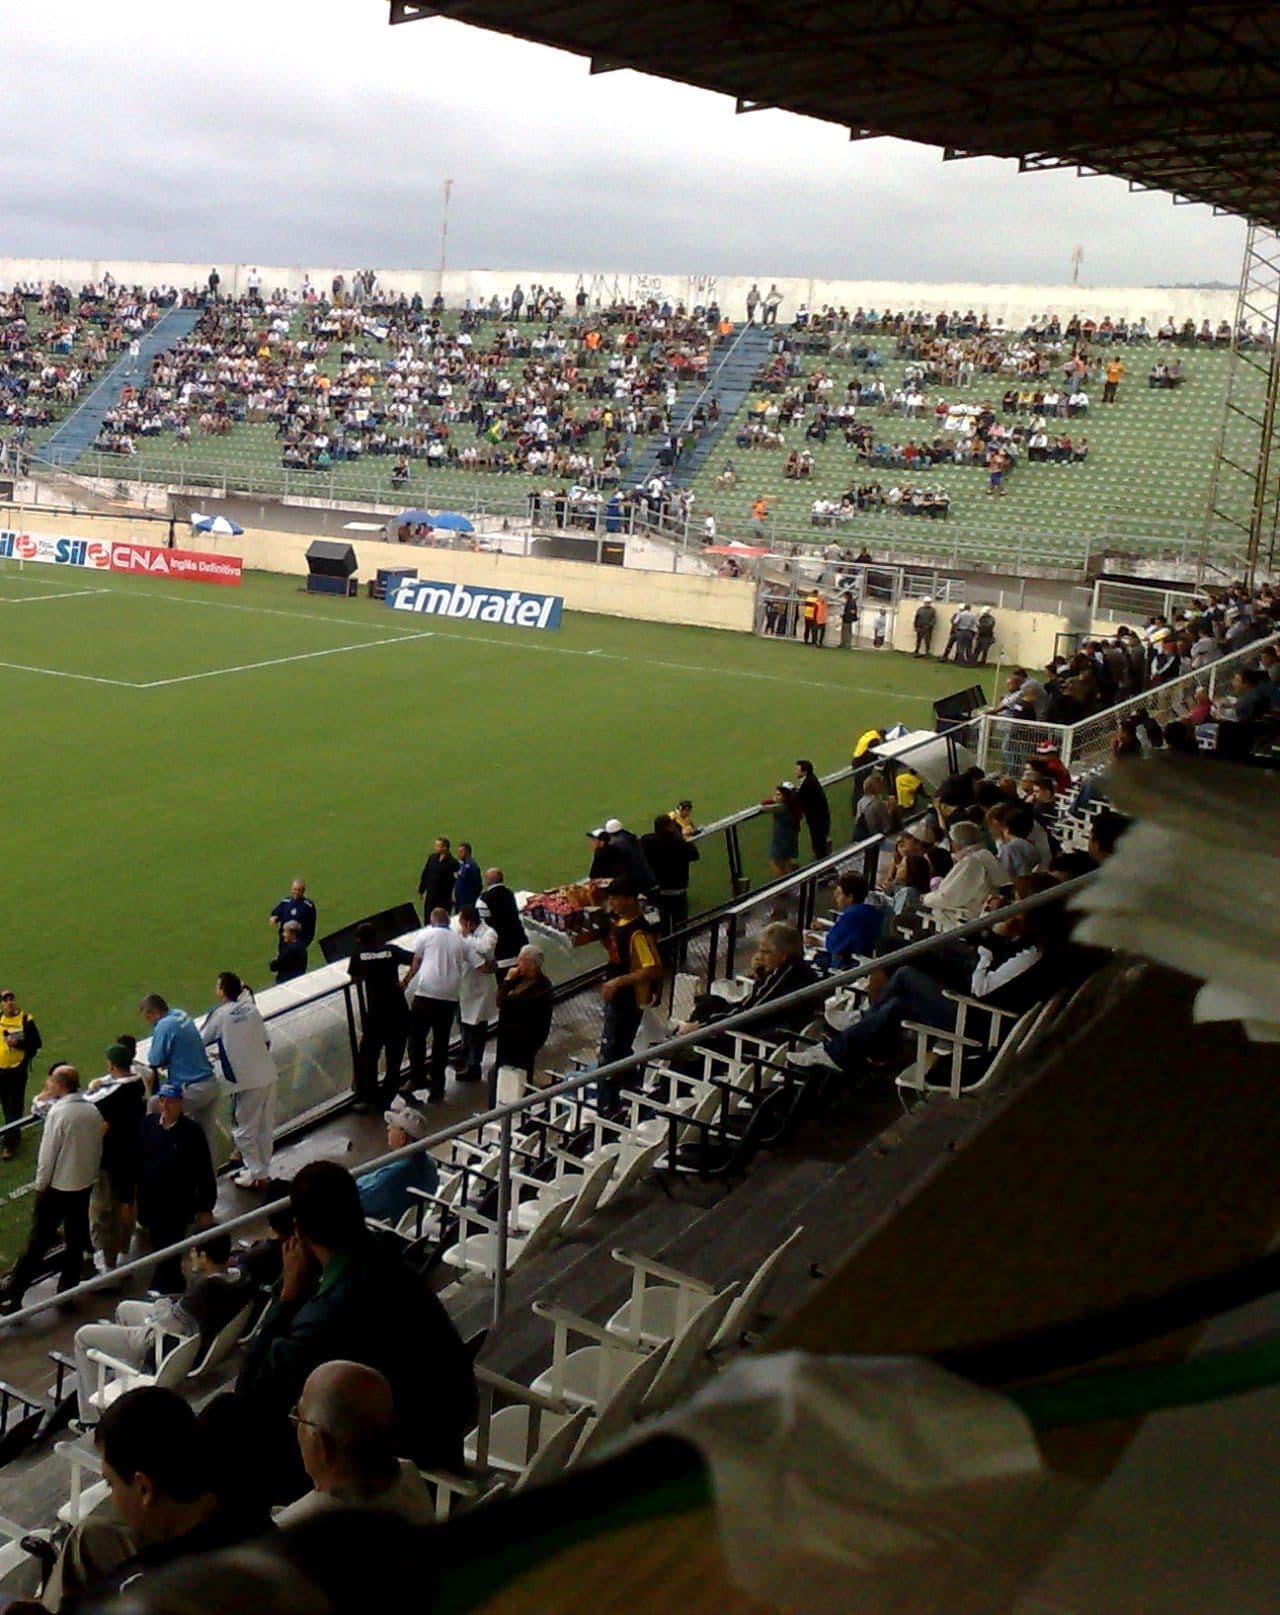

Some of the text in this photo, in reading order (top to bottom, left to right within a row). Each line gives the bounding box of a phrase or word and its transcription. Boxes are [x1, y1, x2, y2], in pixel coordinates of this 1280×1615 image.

[55, 539, 88, 565] Sil
[113, 547, 169, 573] CNA
[393, 577, 554, 629] Embratel
